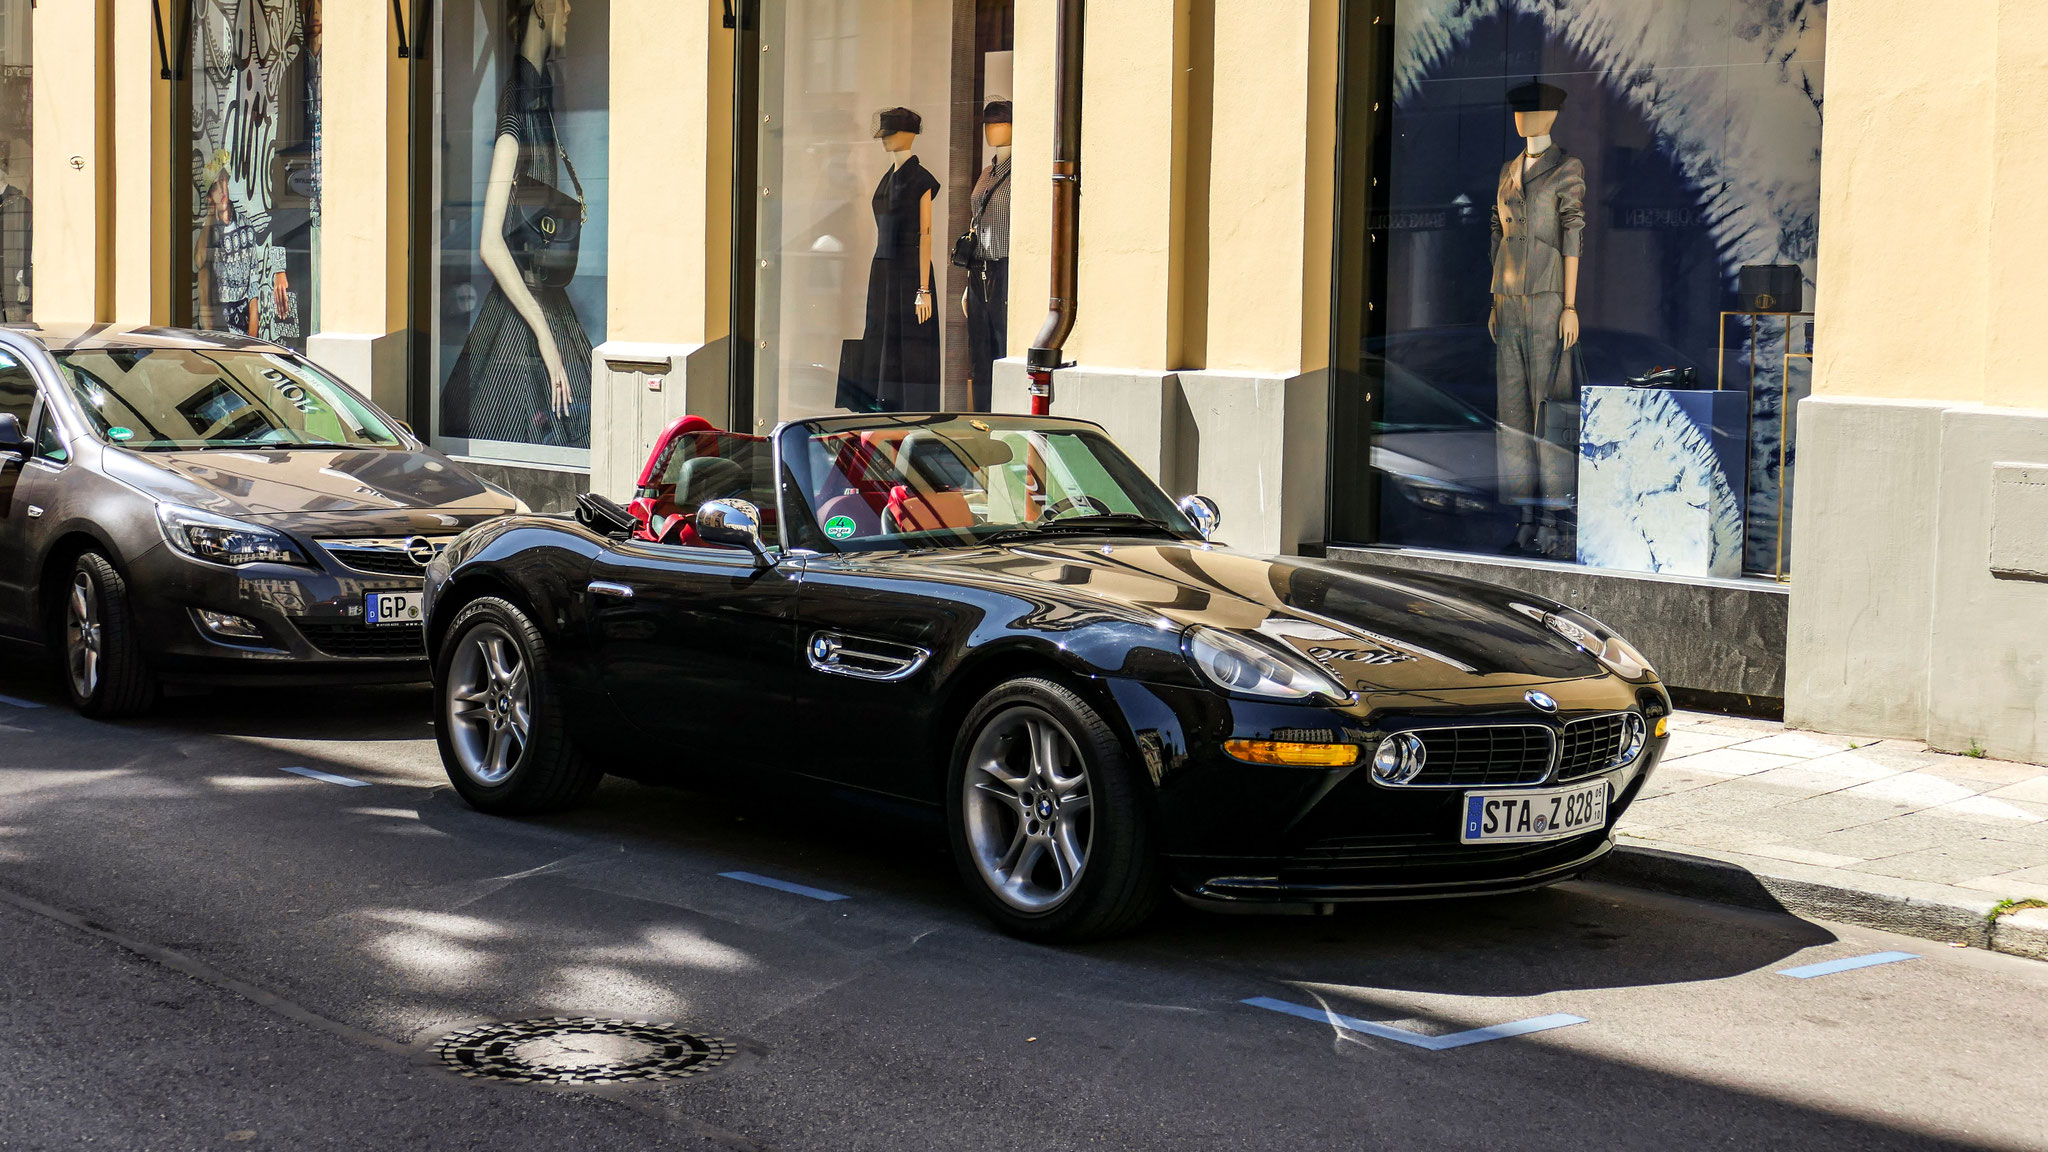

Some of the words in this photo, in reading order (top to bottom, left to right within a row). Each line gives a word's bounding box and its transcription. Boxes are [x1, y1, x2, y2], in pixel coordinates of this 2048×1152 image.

[836, 517, 844, 528] 4
[380, 596, 407, 618] GP
[1470, 822, 1477, 831] D
[1483, 799, 1531, 834] STA
[1548, 797, 1563, 830] Z
[1565, 790, 1593, 827] 828
